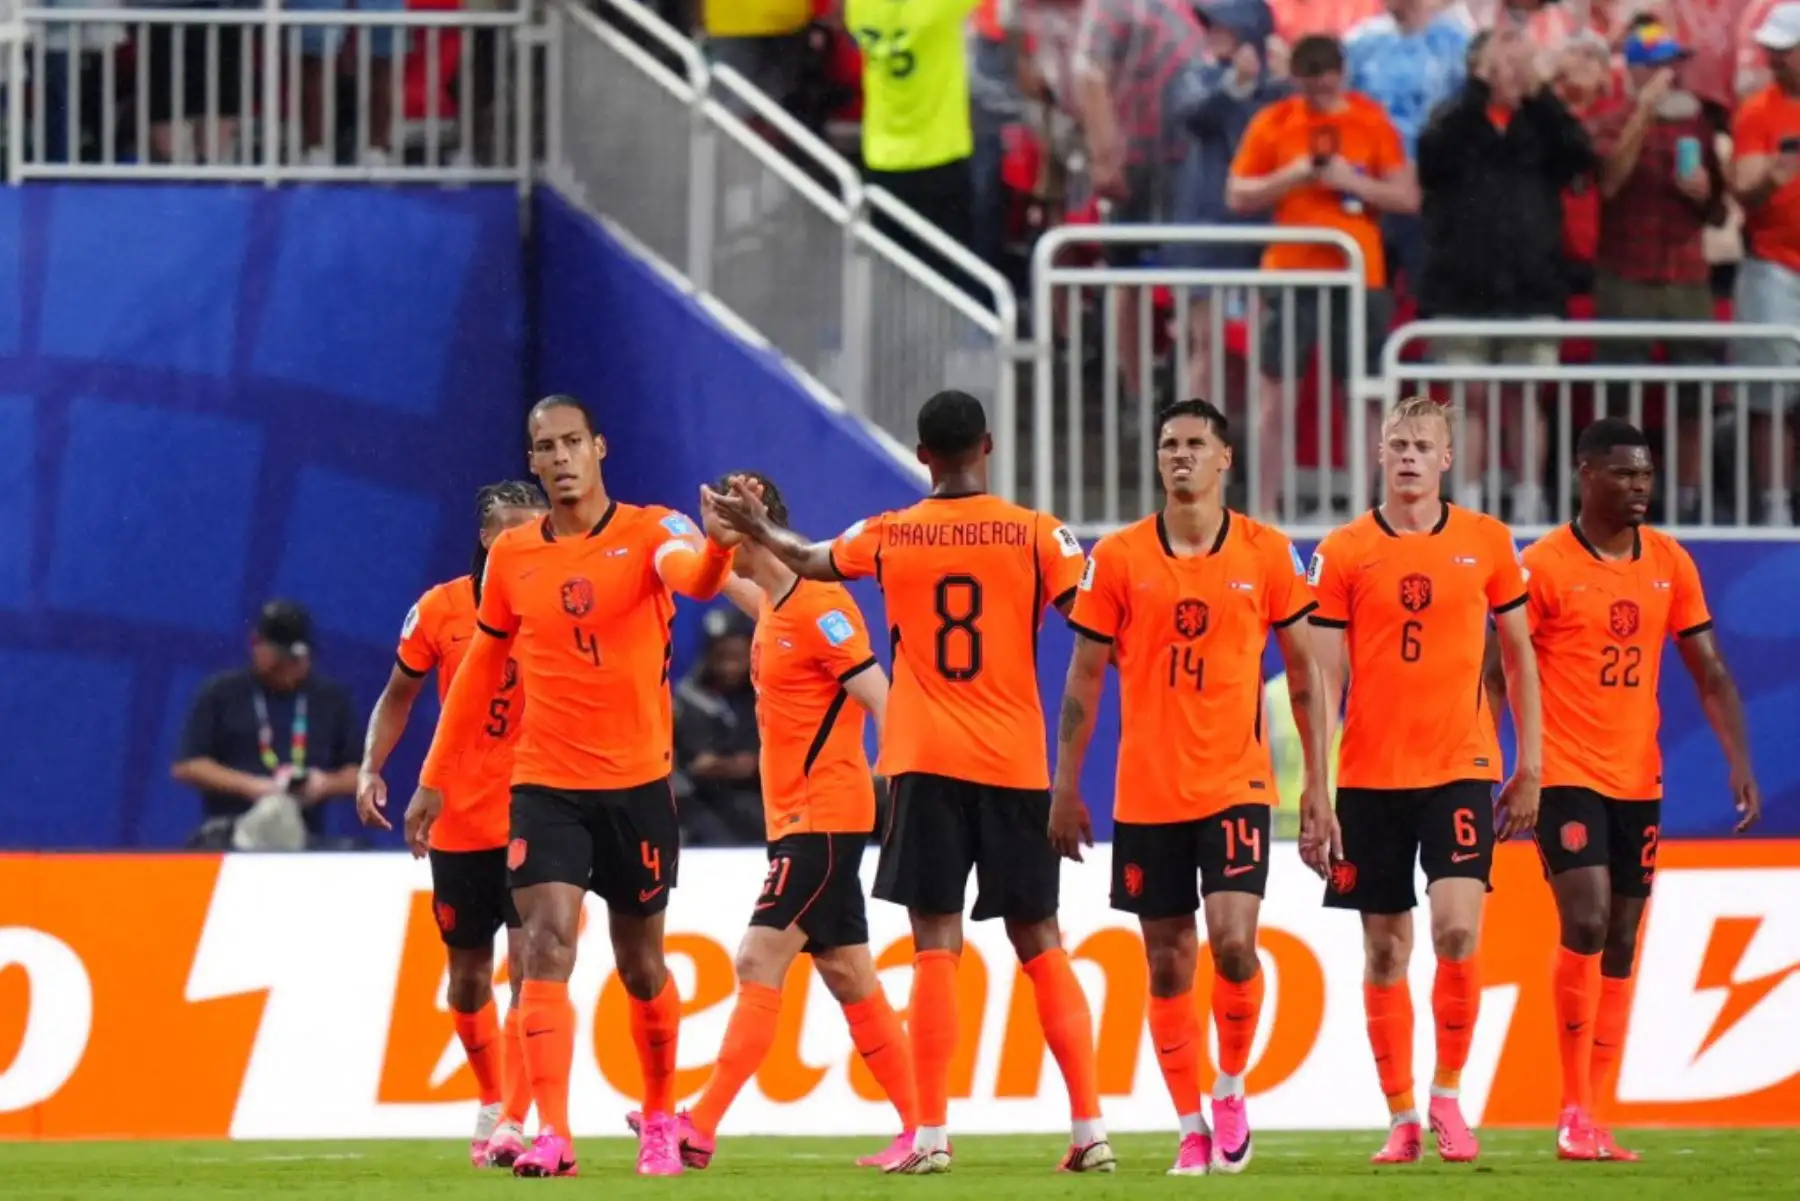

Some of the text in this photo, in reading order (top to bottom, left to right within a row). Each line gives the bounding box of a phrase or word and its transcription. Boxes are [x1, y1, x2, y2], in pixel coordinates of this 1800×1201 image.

[574, 626, 601, 667] 4
[935, 574, 982, 682] 8
[1402, 620, 1422, 662] 6
[1169, 645, 1204, 691] 14
[1600, 646, 1641, 687] 22
[1221, 817, 1261, 862] 14
[1453, 807, 1477, 847] 6
[1641, 824, 1662, 868] 2
[640, 840, 661, 882] 4
